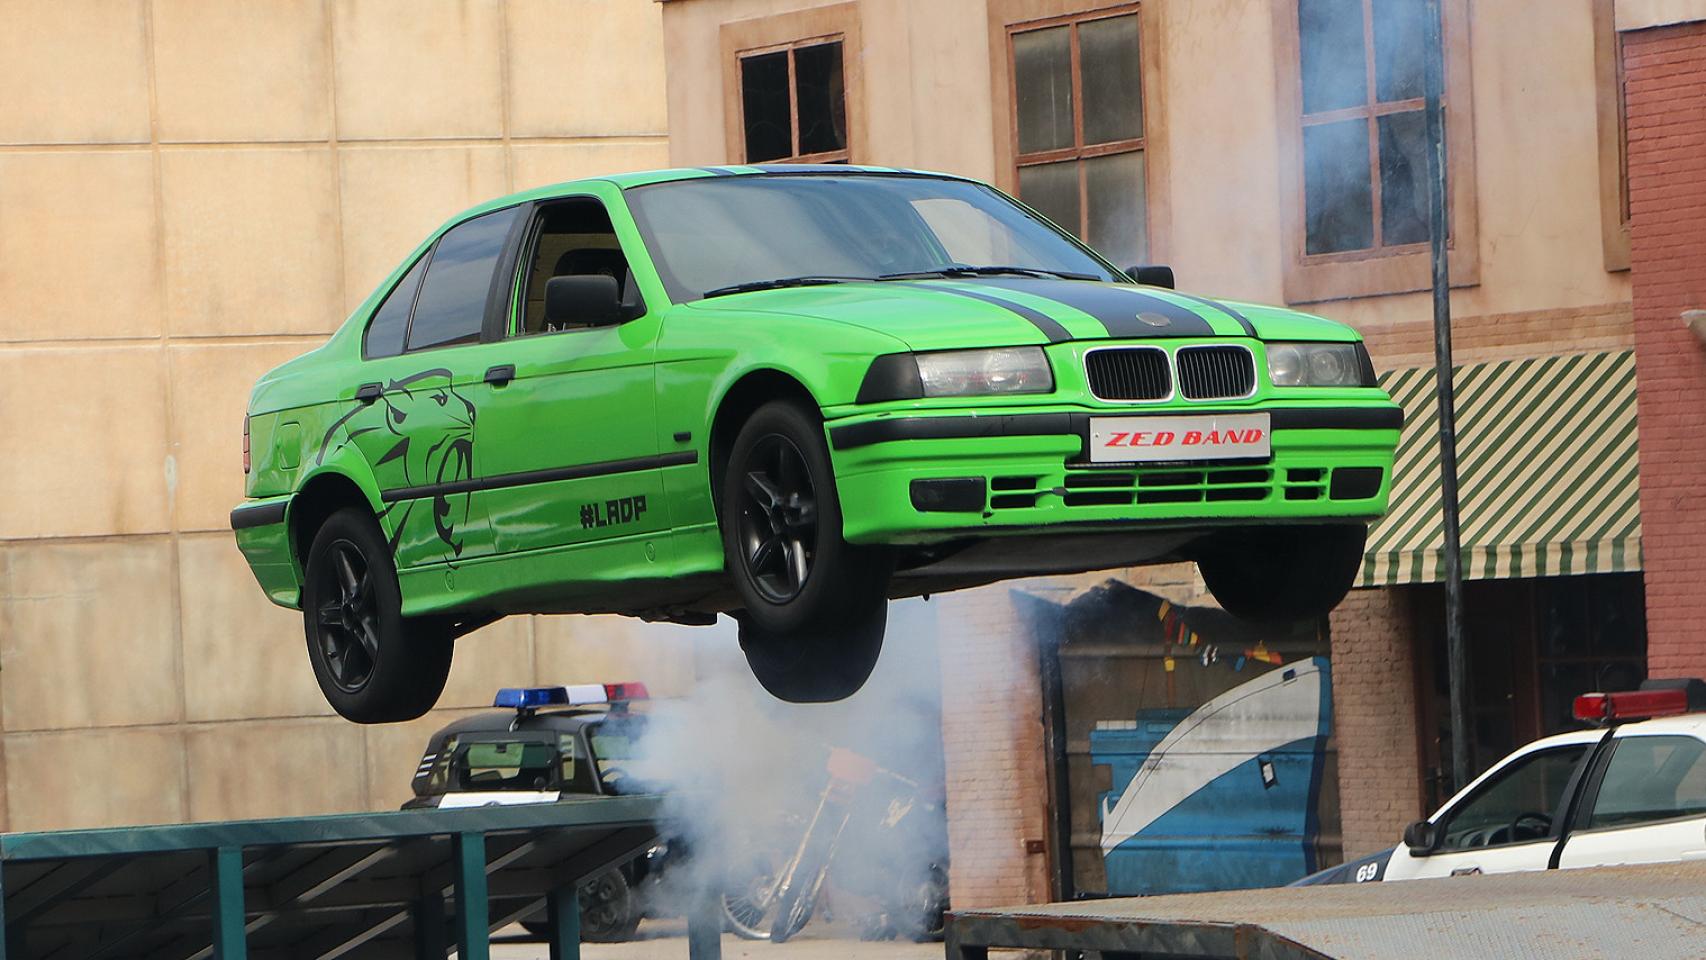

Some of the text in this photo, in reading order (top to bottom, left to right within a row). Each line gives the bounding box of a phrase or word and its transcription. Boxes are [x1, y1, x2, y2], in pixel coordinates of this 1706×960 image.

[1105, 429, 1262, 447] ZED BAND
[1356, 862, 1378, 883] 69
